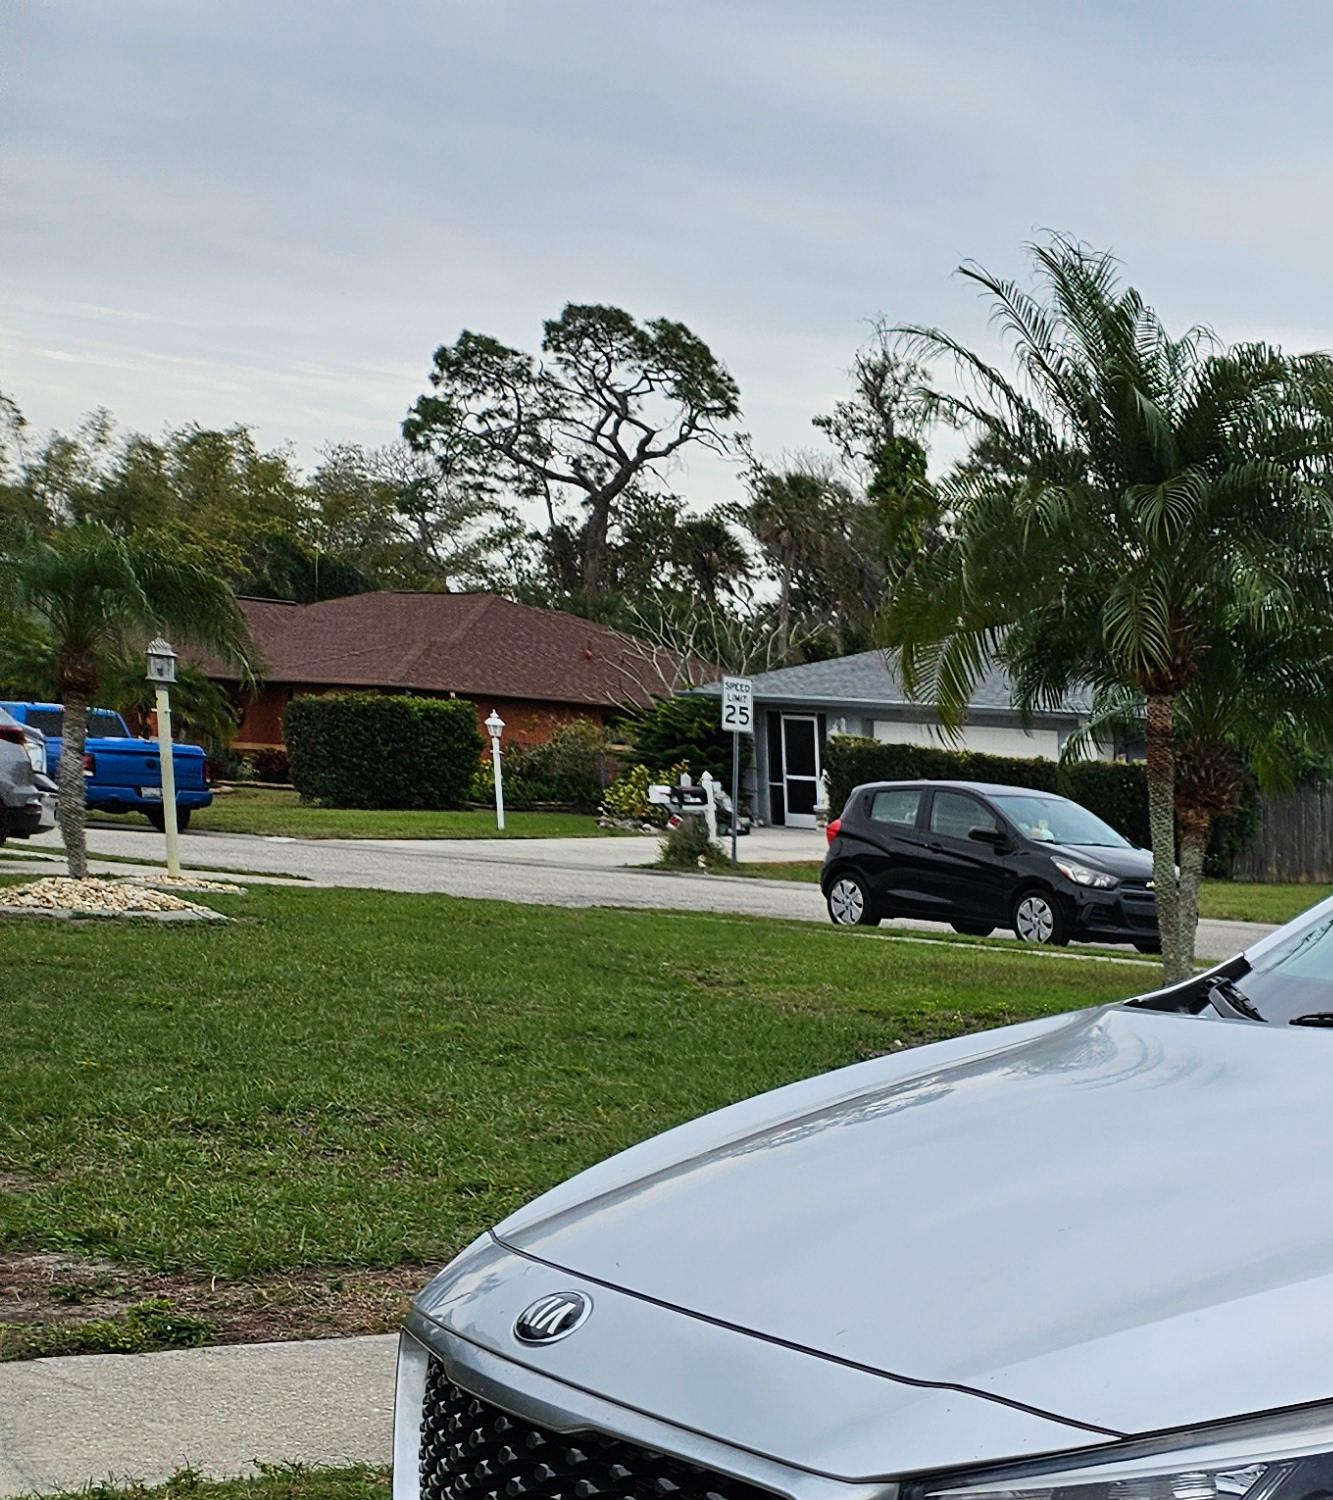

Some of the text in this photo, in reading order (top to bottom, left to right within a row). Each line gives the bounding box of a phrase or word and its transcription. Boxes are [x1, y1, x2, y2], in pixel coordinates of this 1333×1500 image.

[725, 681, 751, 693] SPEED
[725, 704, 750, 726] 25
[518, 1296, 577, 1335] KIA
